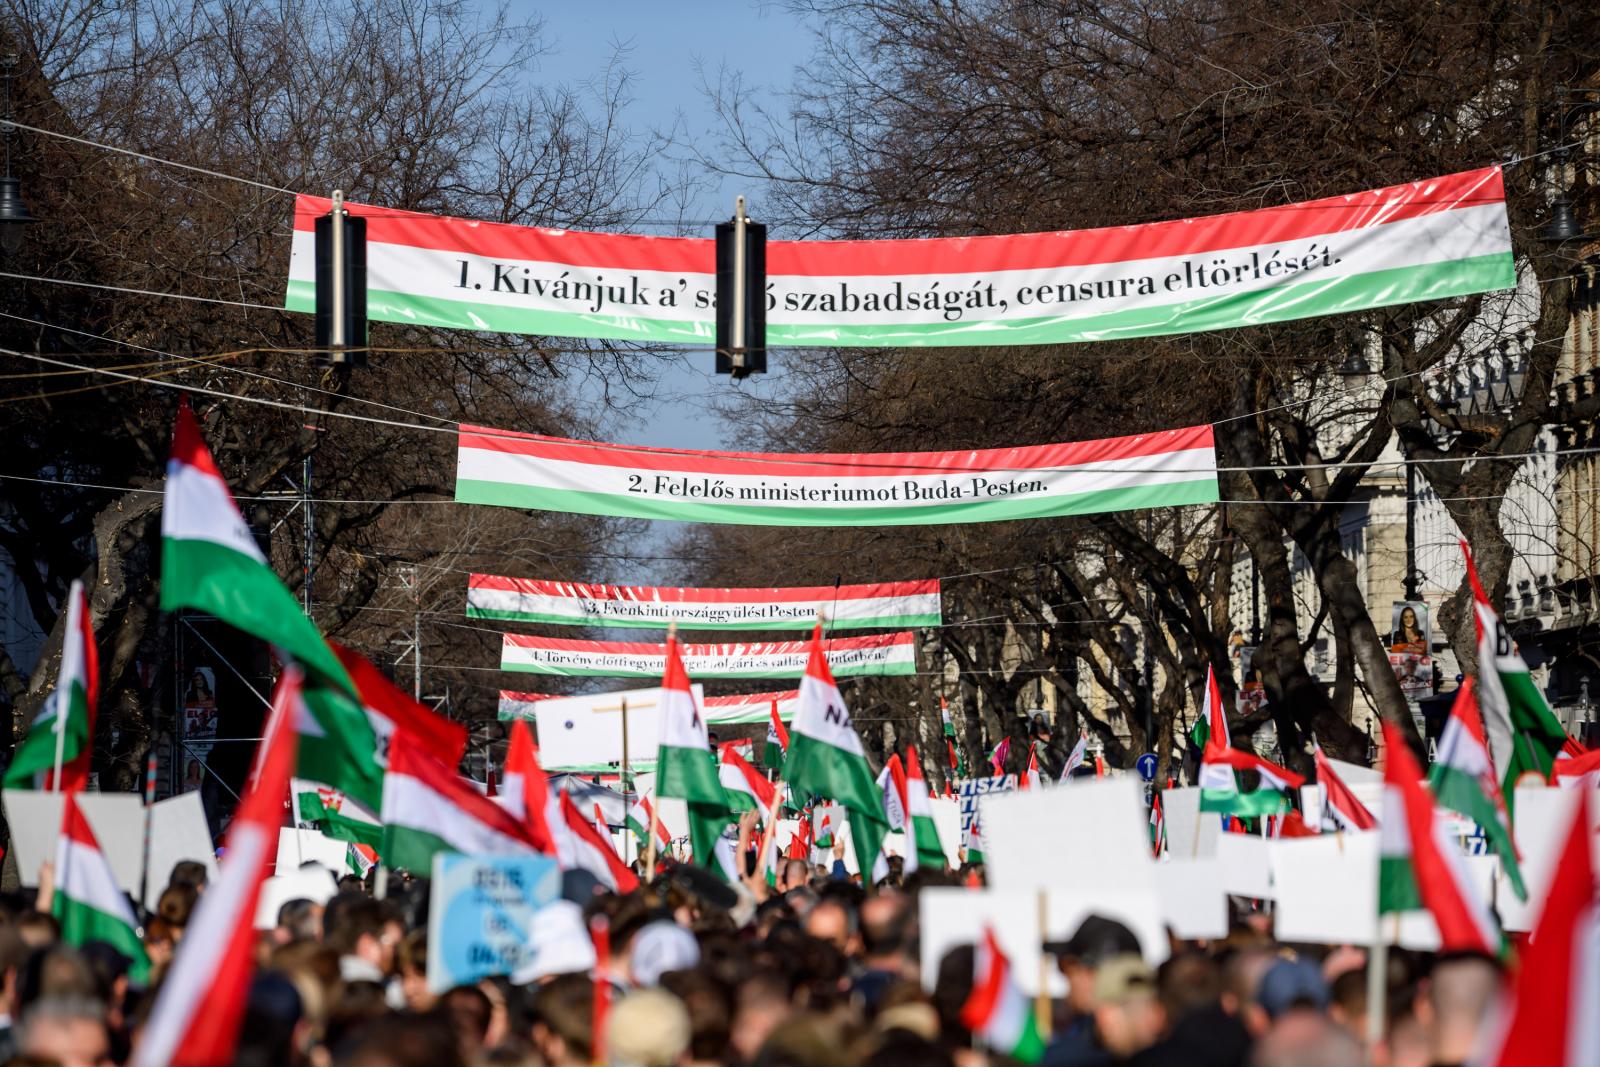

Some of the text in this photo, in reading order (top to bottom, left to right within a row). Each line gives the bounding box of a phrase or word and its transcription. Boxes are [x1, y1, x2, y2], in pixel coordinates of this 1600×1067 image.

[454, 259, 482, 290] 1.
[489, 262, 650, 312] Kivánjuk
[784, 280, 1008, 321] szabadságát,
[1016, 275, 1157, 305] censura
[1164, 243, 1342, 293] eltörlését.
[628, 474, 1048, 502] 2. Felelős ministeriumot Buda-Pesten.
[587, 601, 600, 614] 3.
[959, 775, 1018, 795] TISZA
